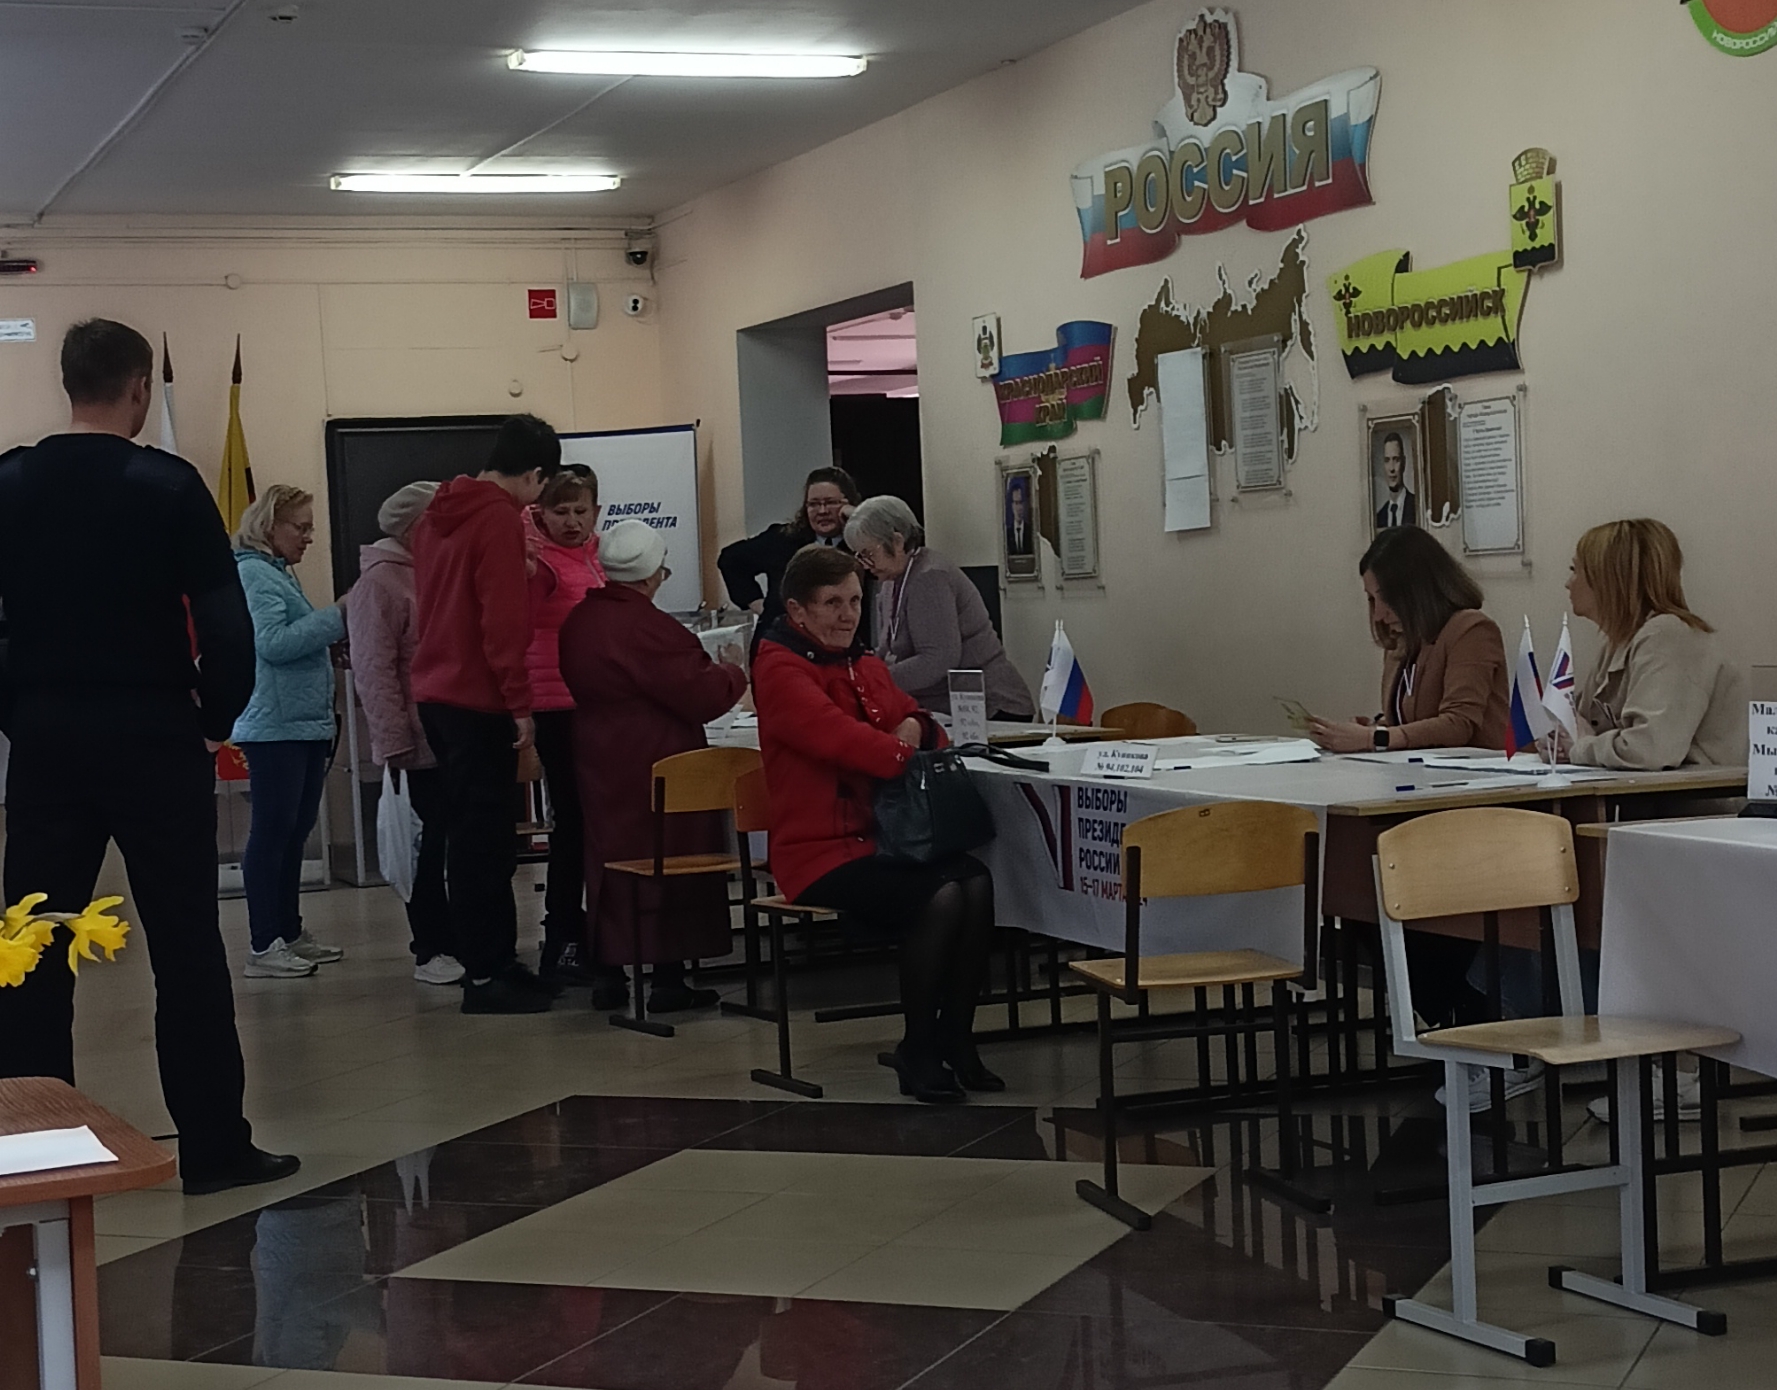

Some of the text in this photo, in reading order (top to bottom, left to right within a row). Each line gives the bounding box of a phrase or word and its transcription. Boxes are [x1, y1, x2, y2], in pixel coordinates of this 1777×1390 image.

[1104, 98, 1332, 244] РОССИЯ
[1347, 286, 1506, 339] НОВОРОССИЙСК
[1000, 357, 1103, 403] КРАСНОДАРСКИЙ
[1035, 399, 1067, 427] КРАЙ
[607, 502, 661, 516] ВЫБОРЫ
[1077, 786, 1128, 813] ВЫБОРЫ
[1079, 847, 1120, 875] РОССИИ
